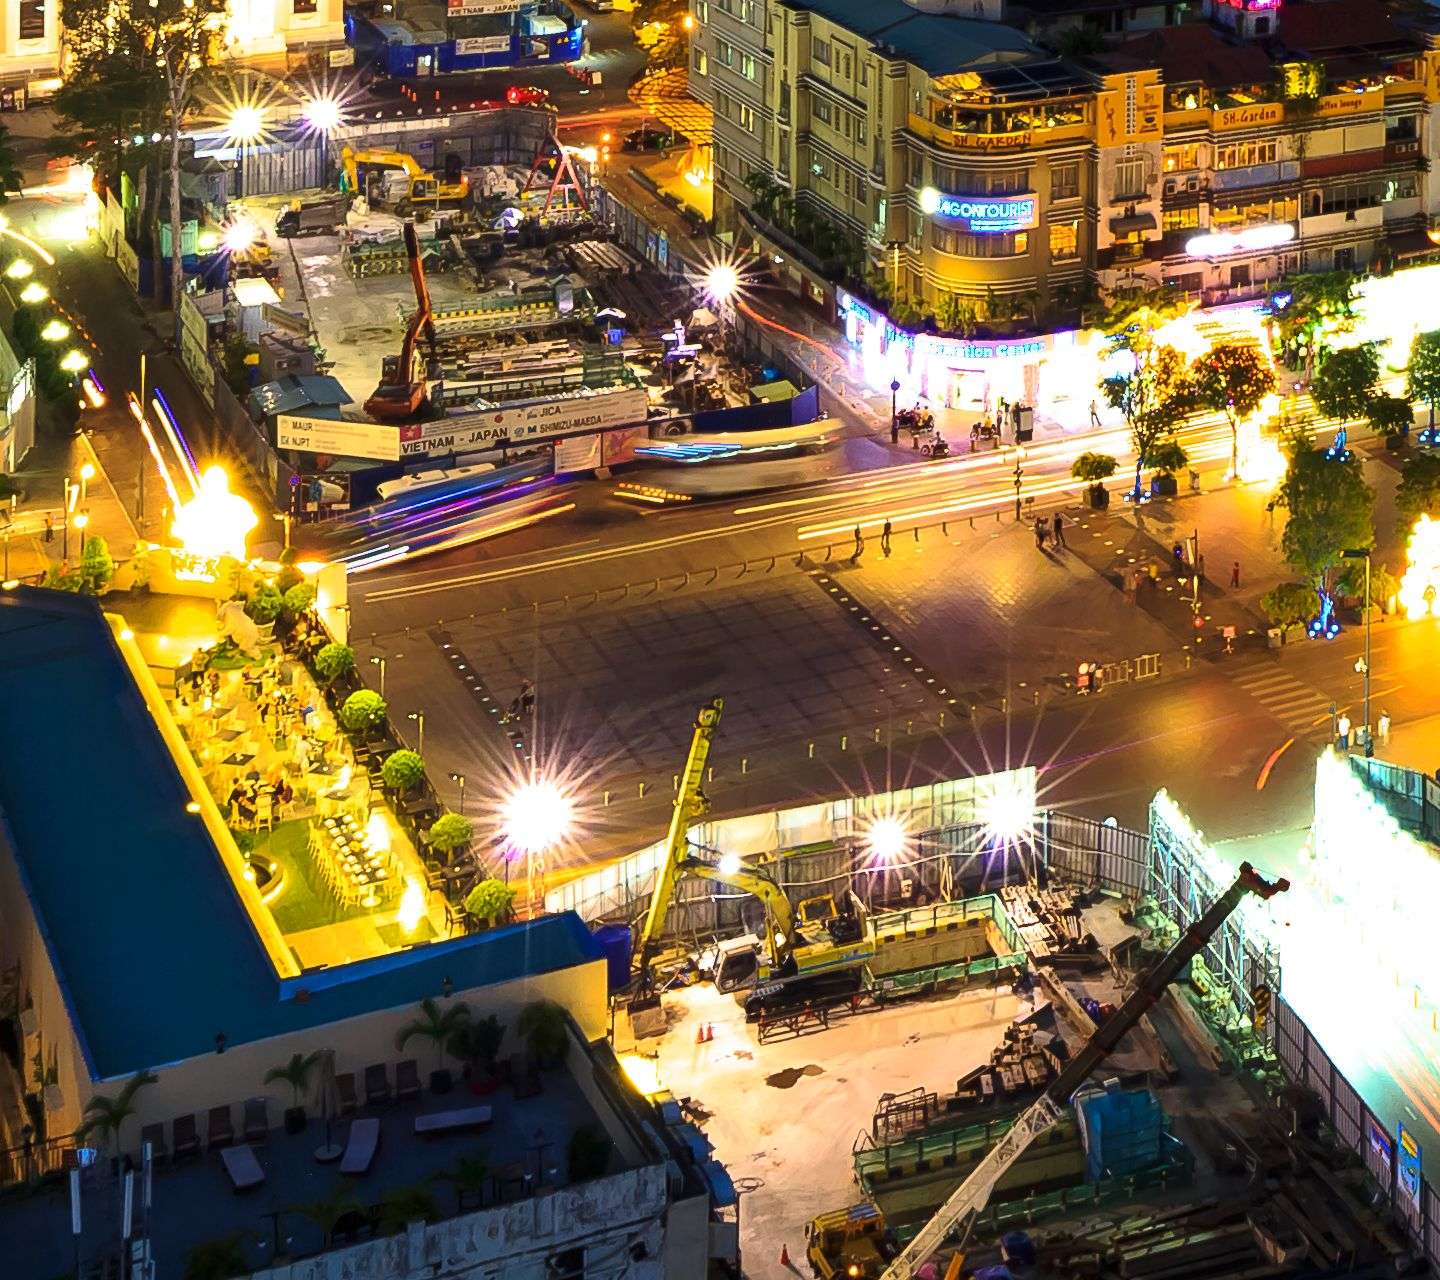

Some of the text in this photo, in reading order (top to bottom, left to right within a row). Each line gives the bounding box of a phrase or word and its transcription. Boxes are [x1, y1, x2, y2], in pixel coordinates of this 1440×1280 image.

[493, 4, 519, 13] JAPAN
[540, 406, 562, 417] JICA
[401, 435, 455, 454] VIETNAM
[468, 427, 508, 443] JAPAN
